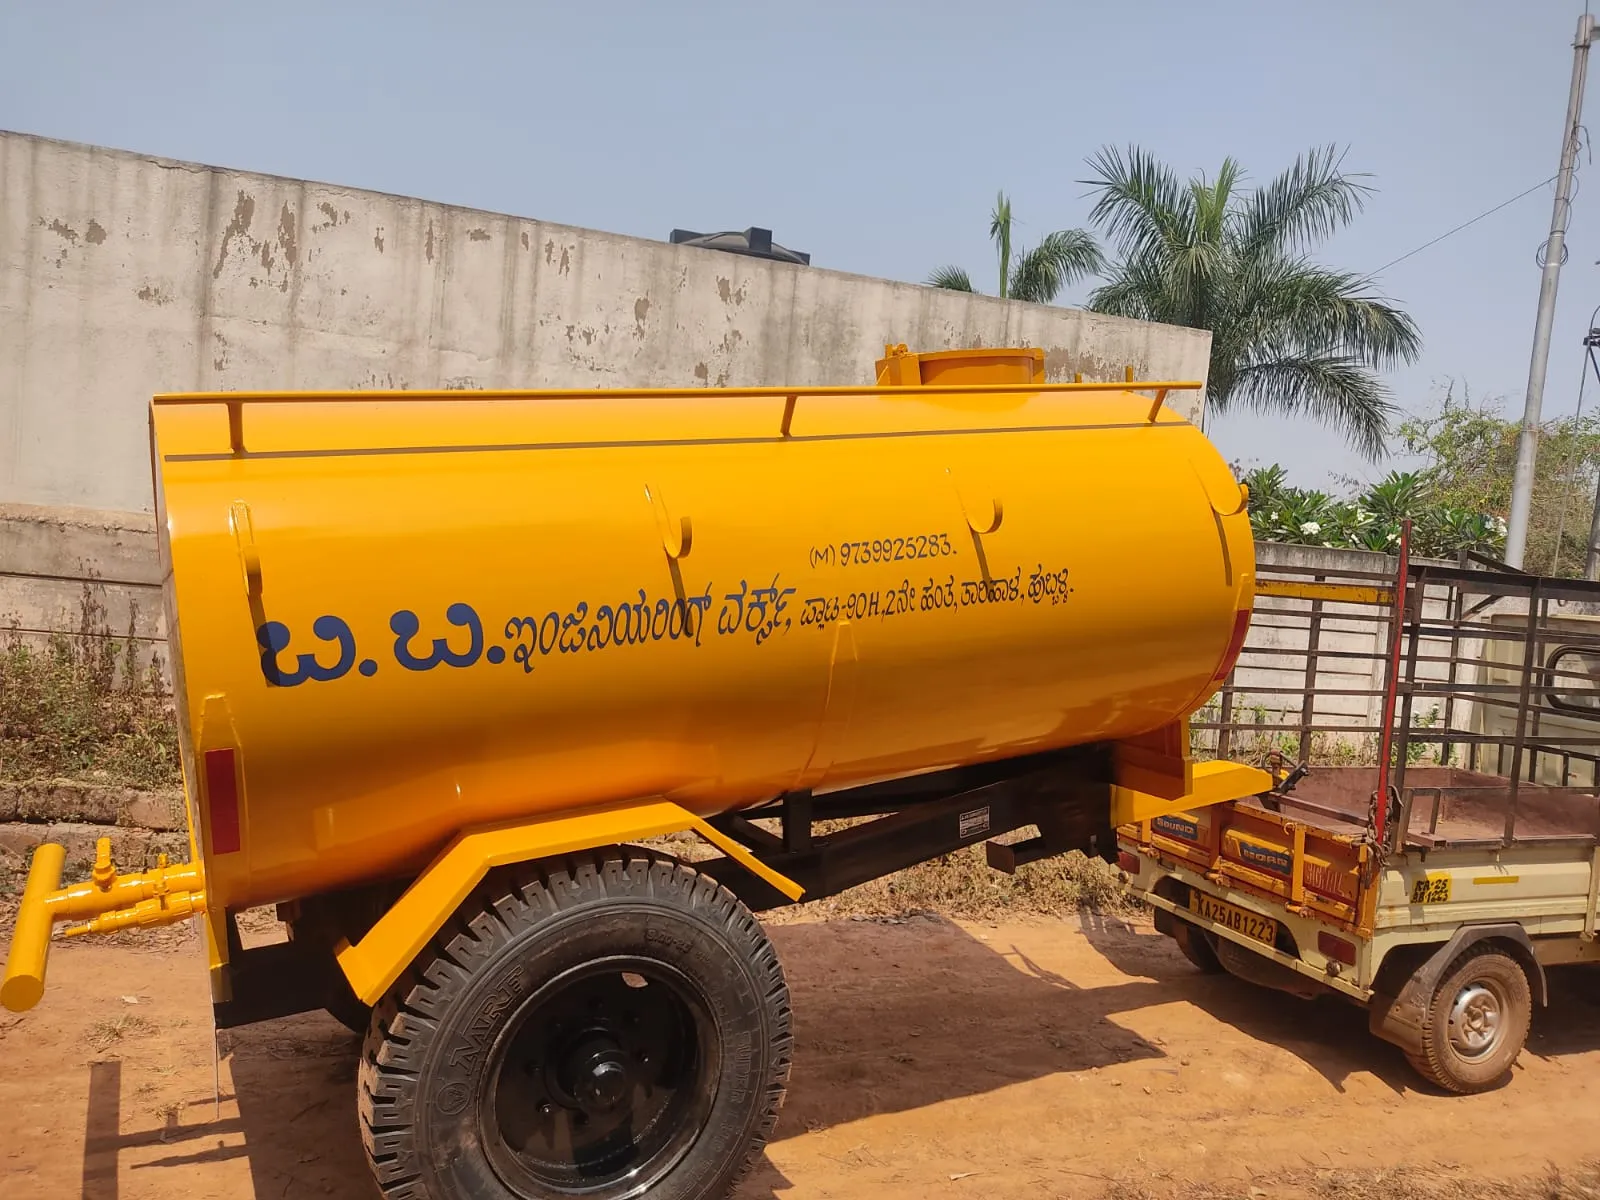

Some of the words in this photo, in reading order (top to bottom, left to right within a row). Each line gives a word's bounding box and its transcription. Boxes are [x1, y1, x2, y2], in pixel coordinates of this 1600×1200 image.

[809, 544, 836, 568] (M)
[840, 533, 957, 566] 9739925283.
[1157, 817, 1195, 834] SOUND
[1243, 848, 1289, 867] HORN
[1196, 897, 1275, 943] KA25AB1223
[450, 964, 525, 1077] MRF
